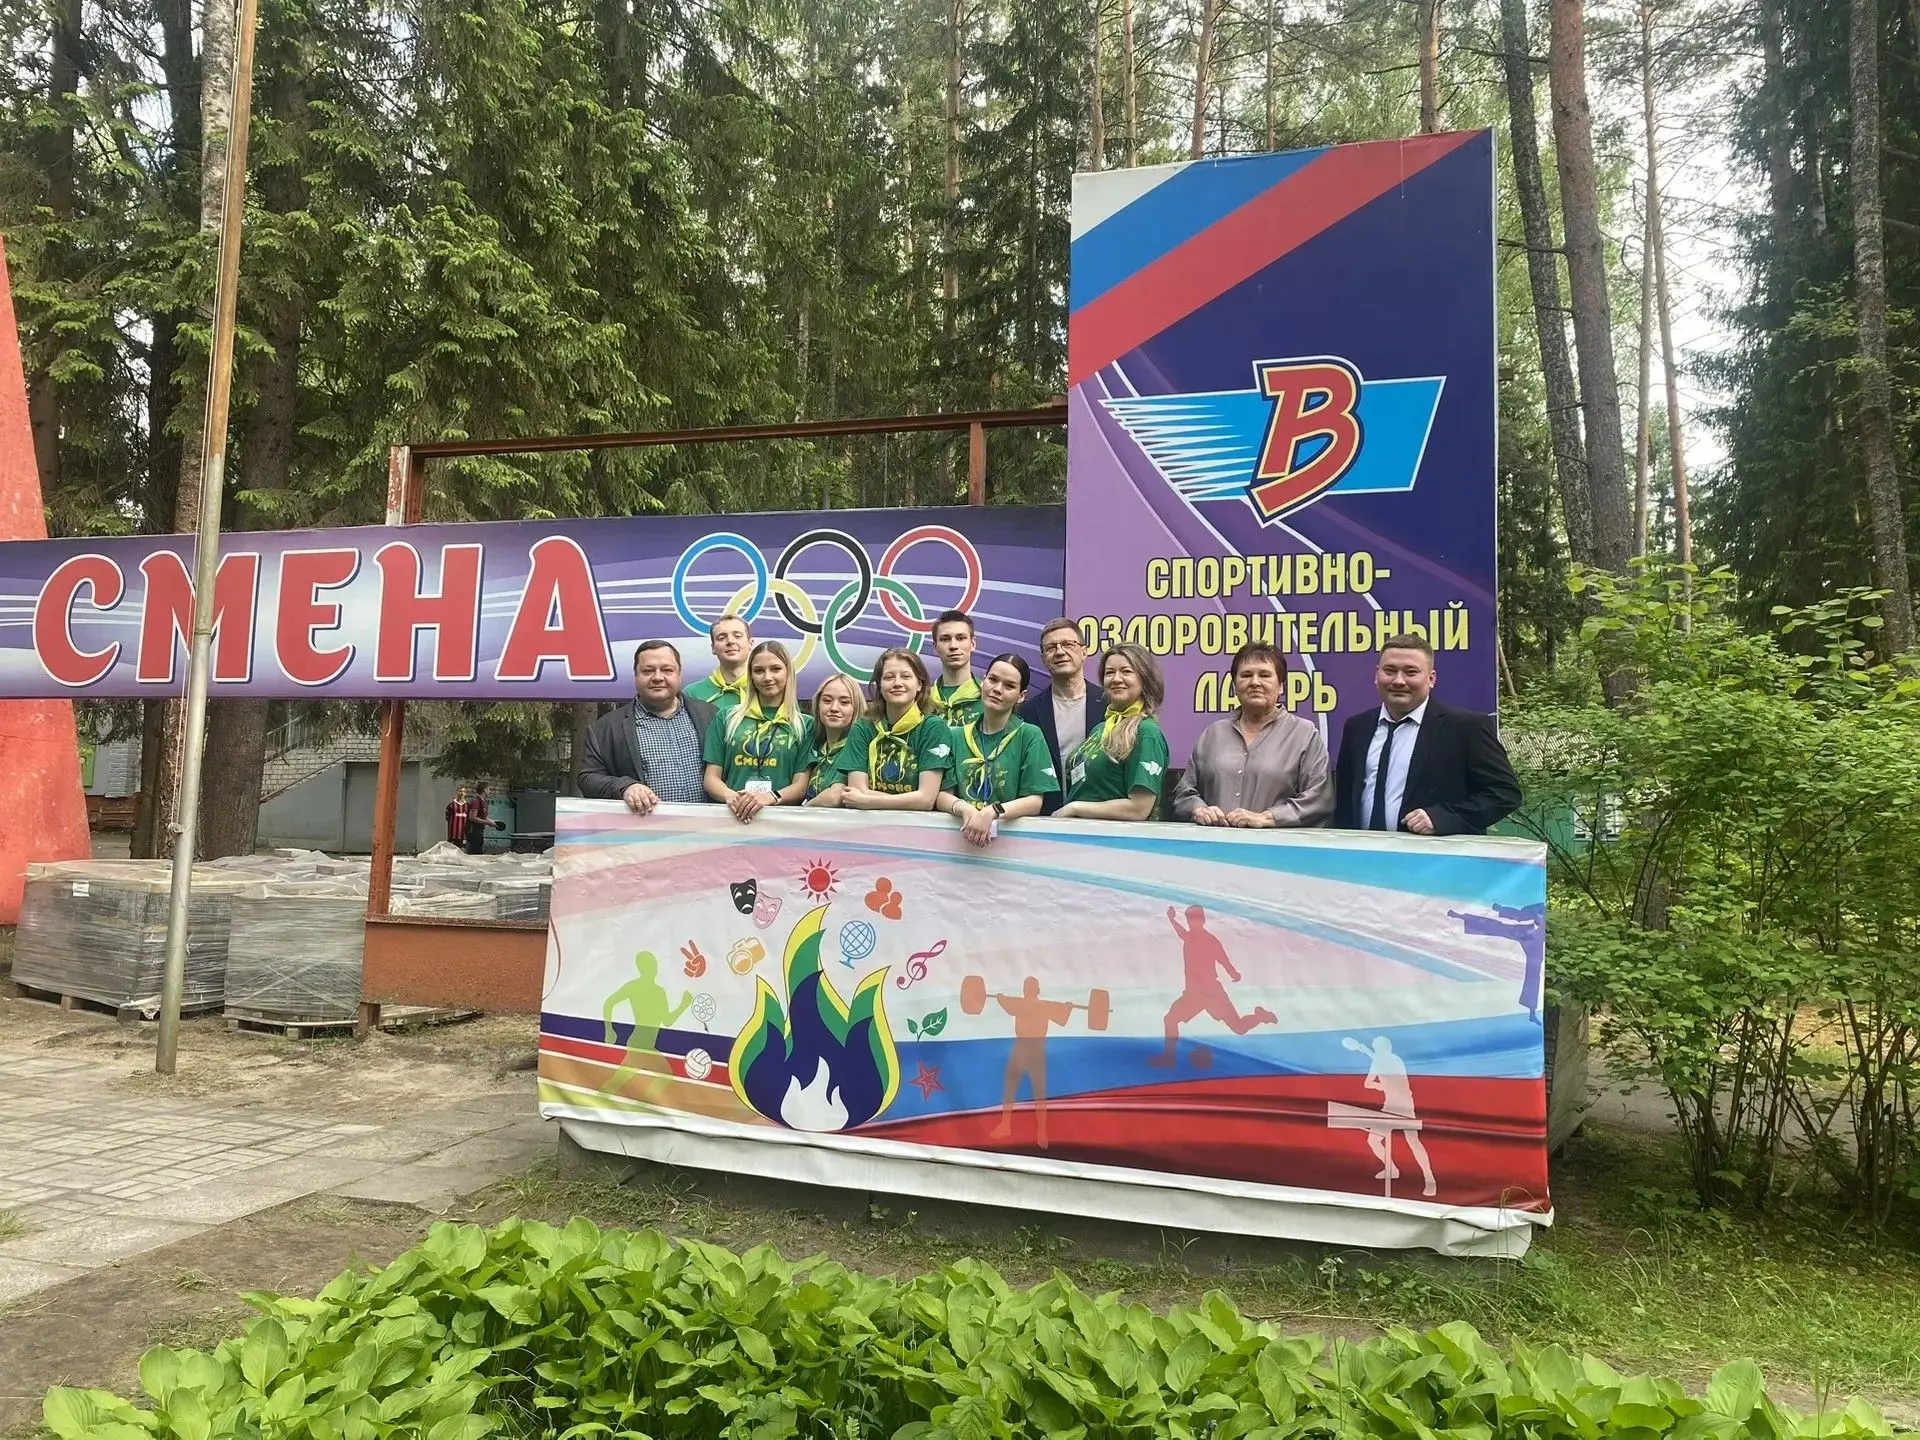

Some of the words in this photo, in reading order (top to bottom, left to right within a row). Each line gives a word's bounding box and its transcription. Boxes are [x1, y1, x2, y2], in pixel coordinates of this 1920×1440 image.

[1146, 551, 1391, 599] СПОРТИВНО-
[33, 535, 618, 686] СМЕНА
[1194, 670, 1338, 713] ЛАРЬ
